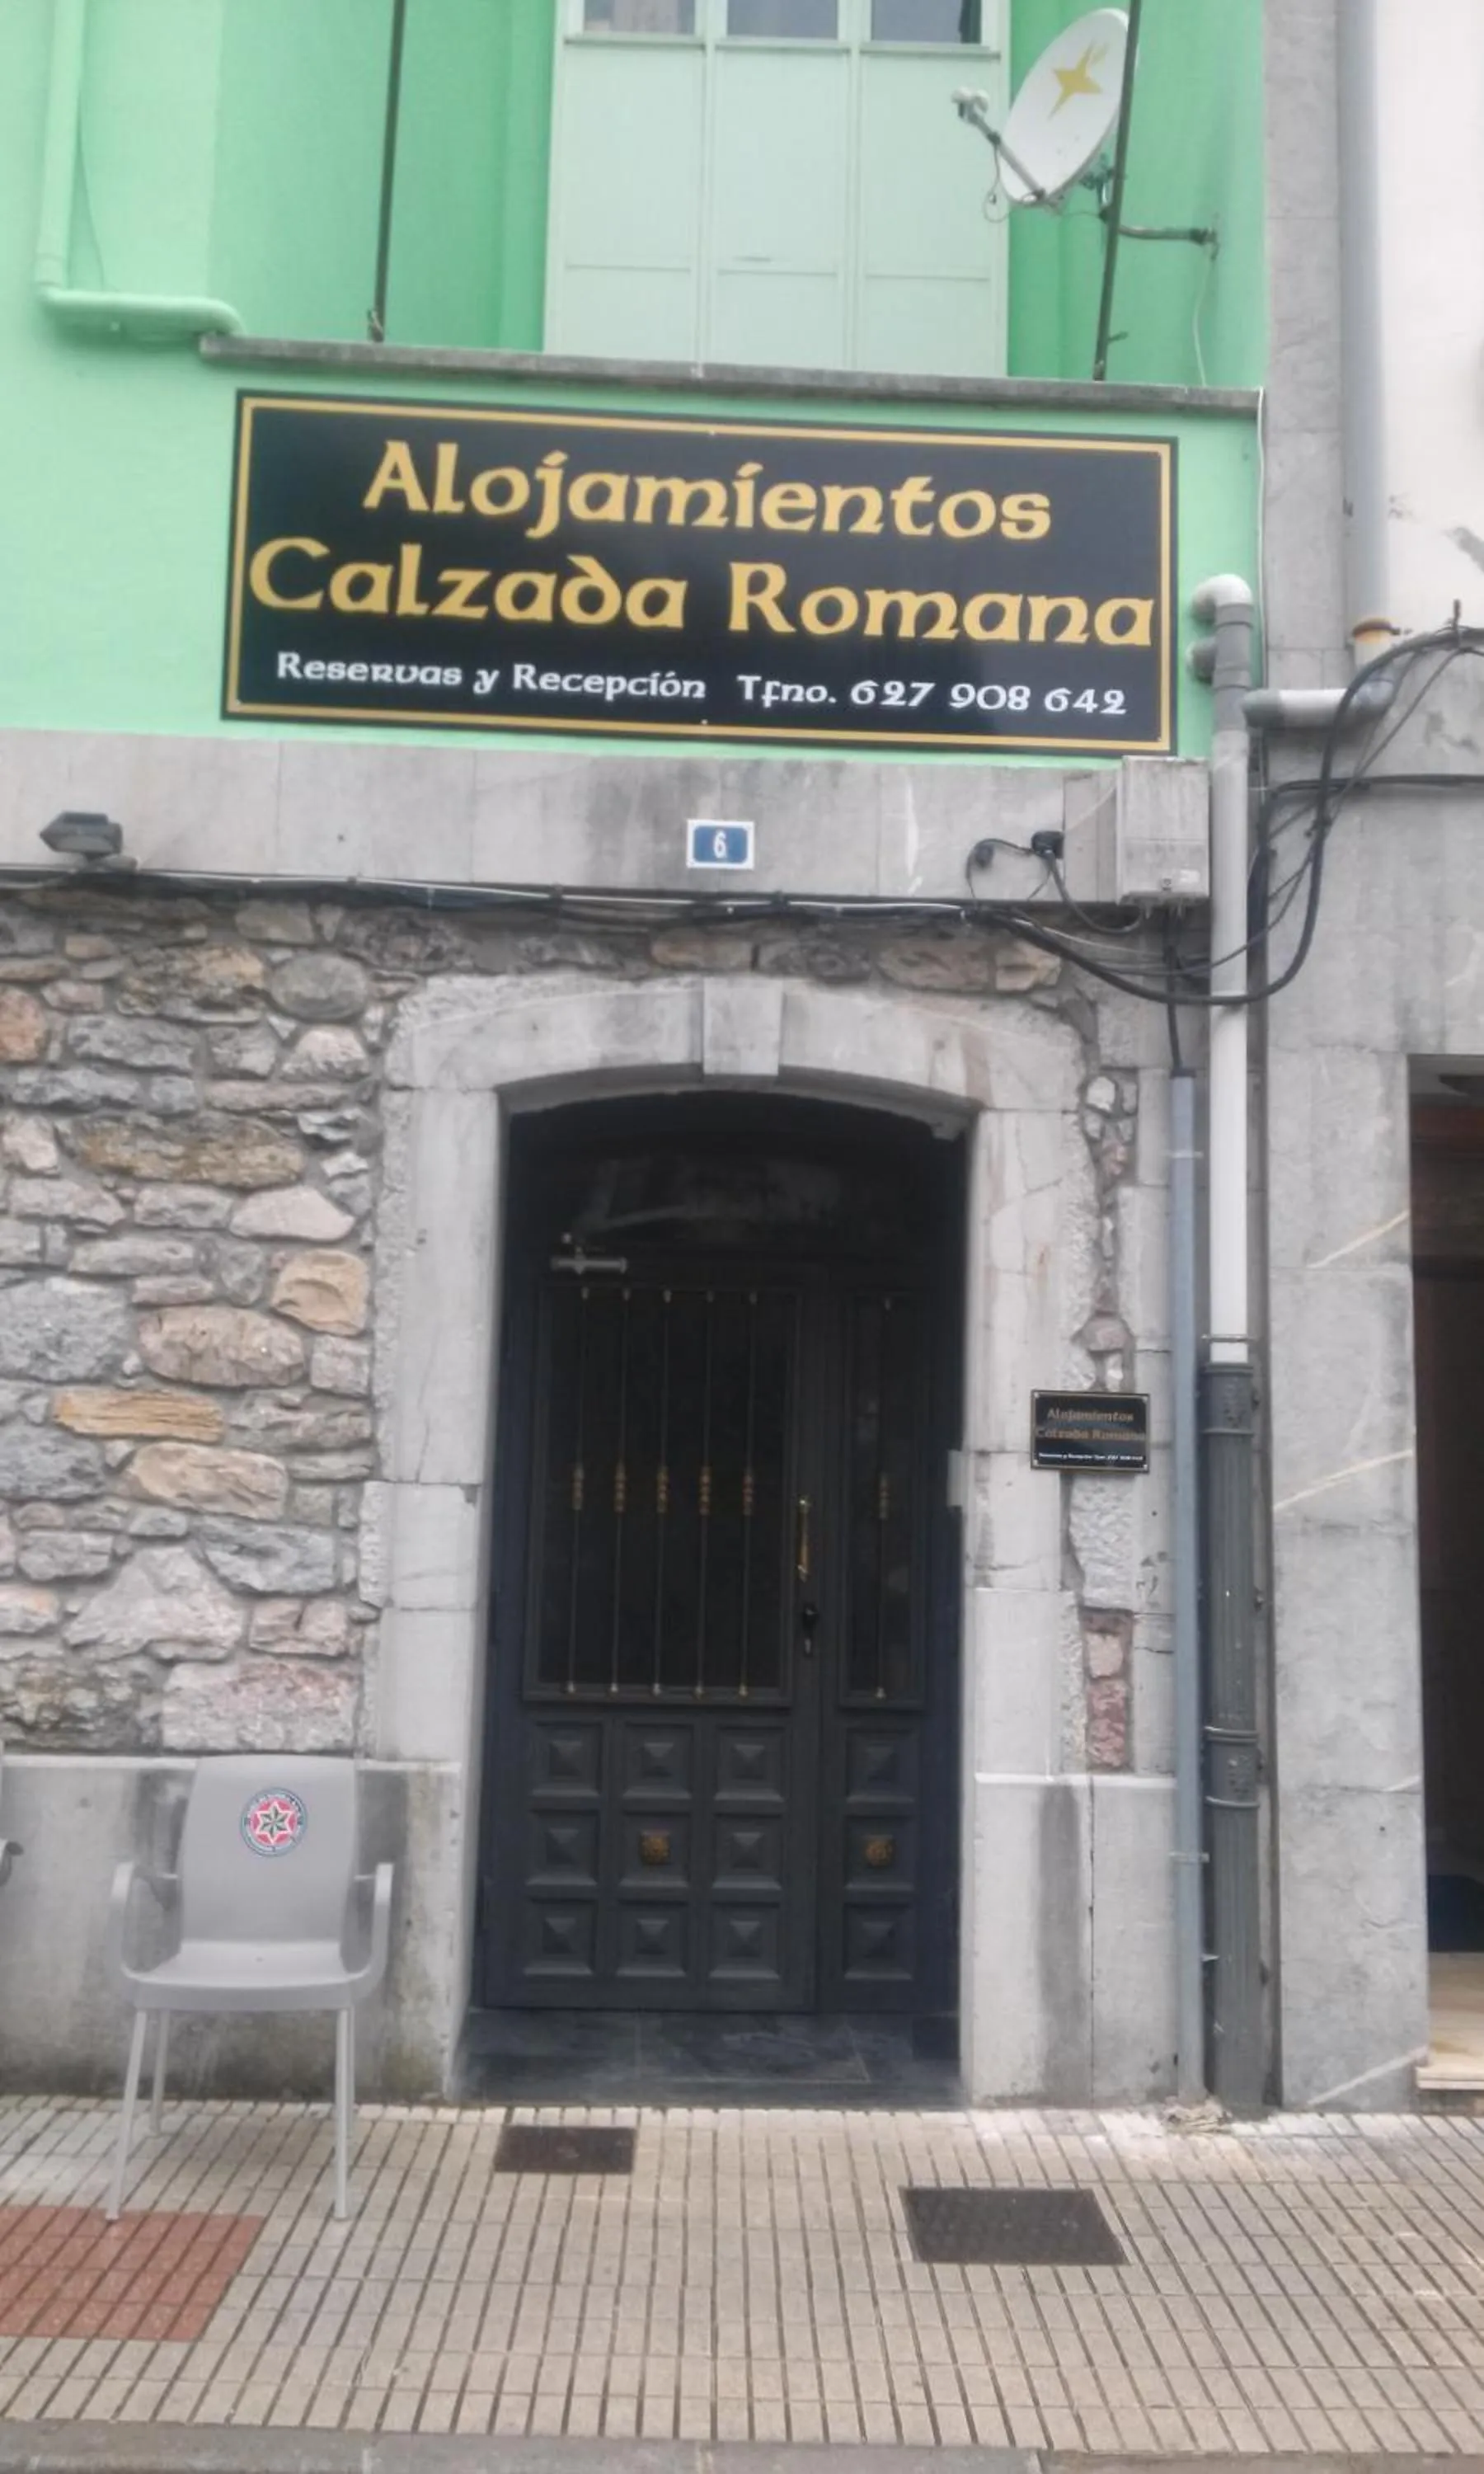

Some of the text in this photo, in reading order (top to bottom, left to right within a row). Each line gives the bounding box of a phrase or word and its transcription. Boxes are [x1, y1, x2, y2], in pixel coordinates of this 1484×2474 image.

[362, 440, 1051, 540] Alojamientos
[250, 537, 1153, 647] Calzada Romana
[277, 651, 1127, 715] Reservas y Recepción Tfno. 627 908 642
[714, 829, 727, 858] 6
